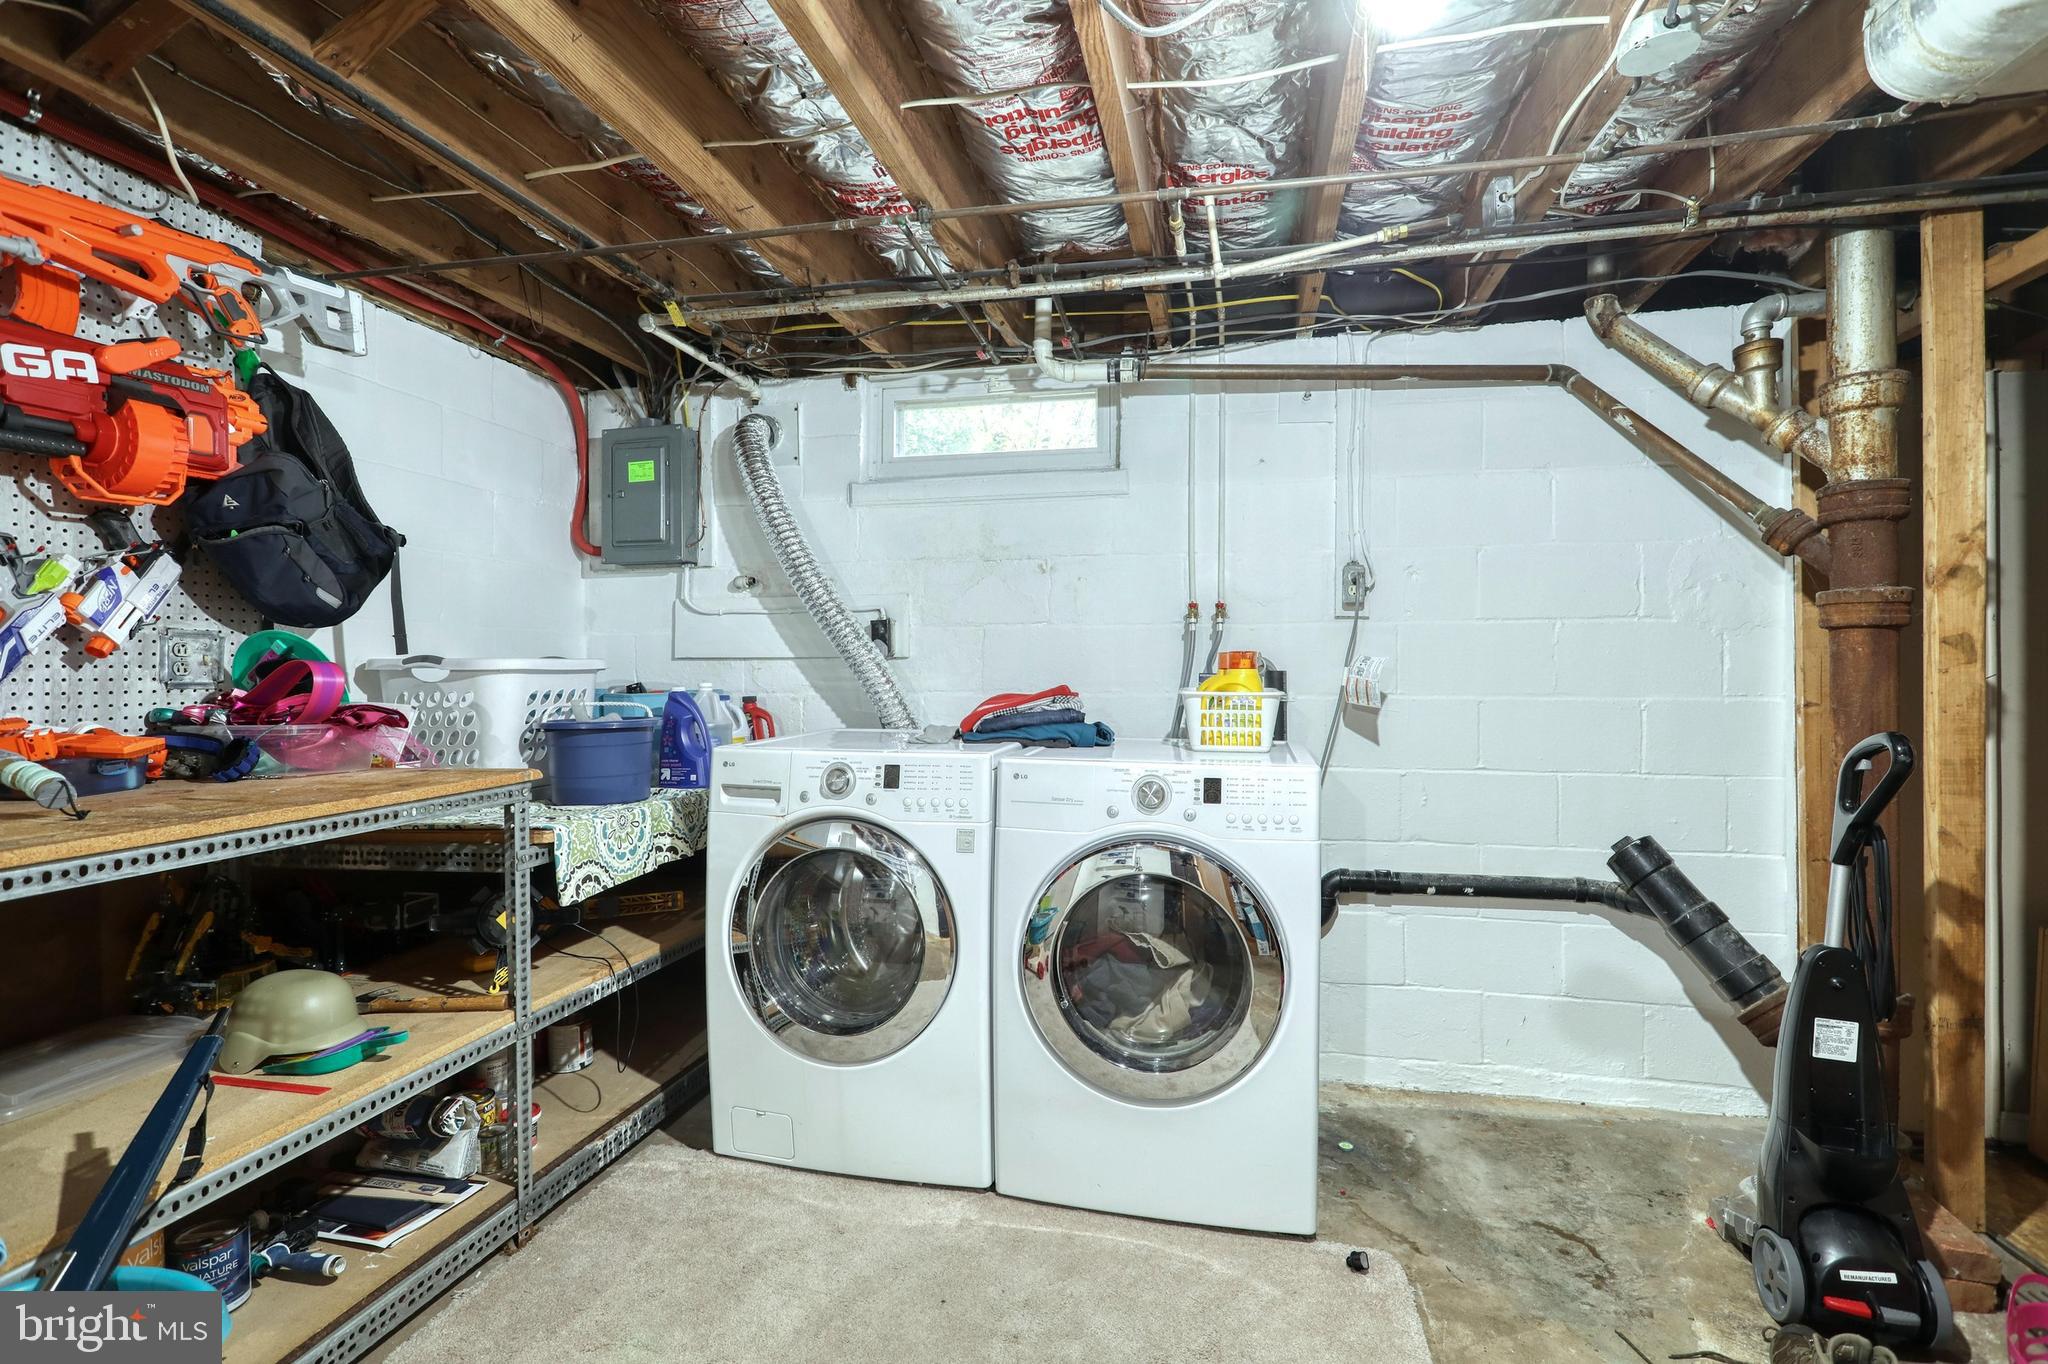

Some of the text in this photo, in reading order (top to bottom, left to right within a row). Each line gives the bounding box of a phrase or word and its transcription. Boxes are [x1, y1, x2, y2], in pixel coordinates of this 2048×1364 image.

[1180, 168, 1271, 185] berglas
[128, 368, 211, 394] MASTODON
[28, 611, 61, 645] ELITE
[182, 1248, 234, 1272] valspar
[1843, 1273, 1892, 1282] REMANUFACTURED
